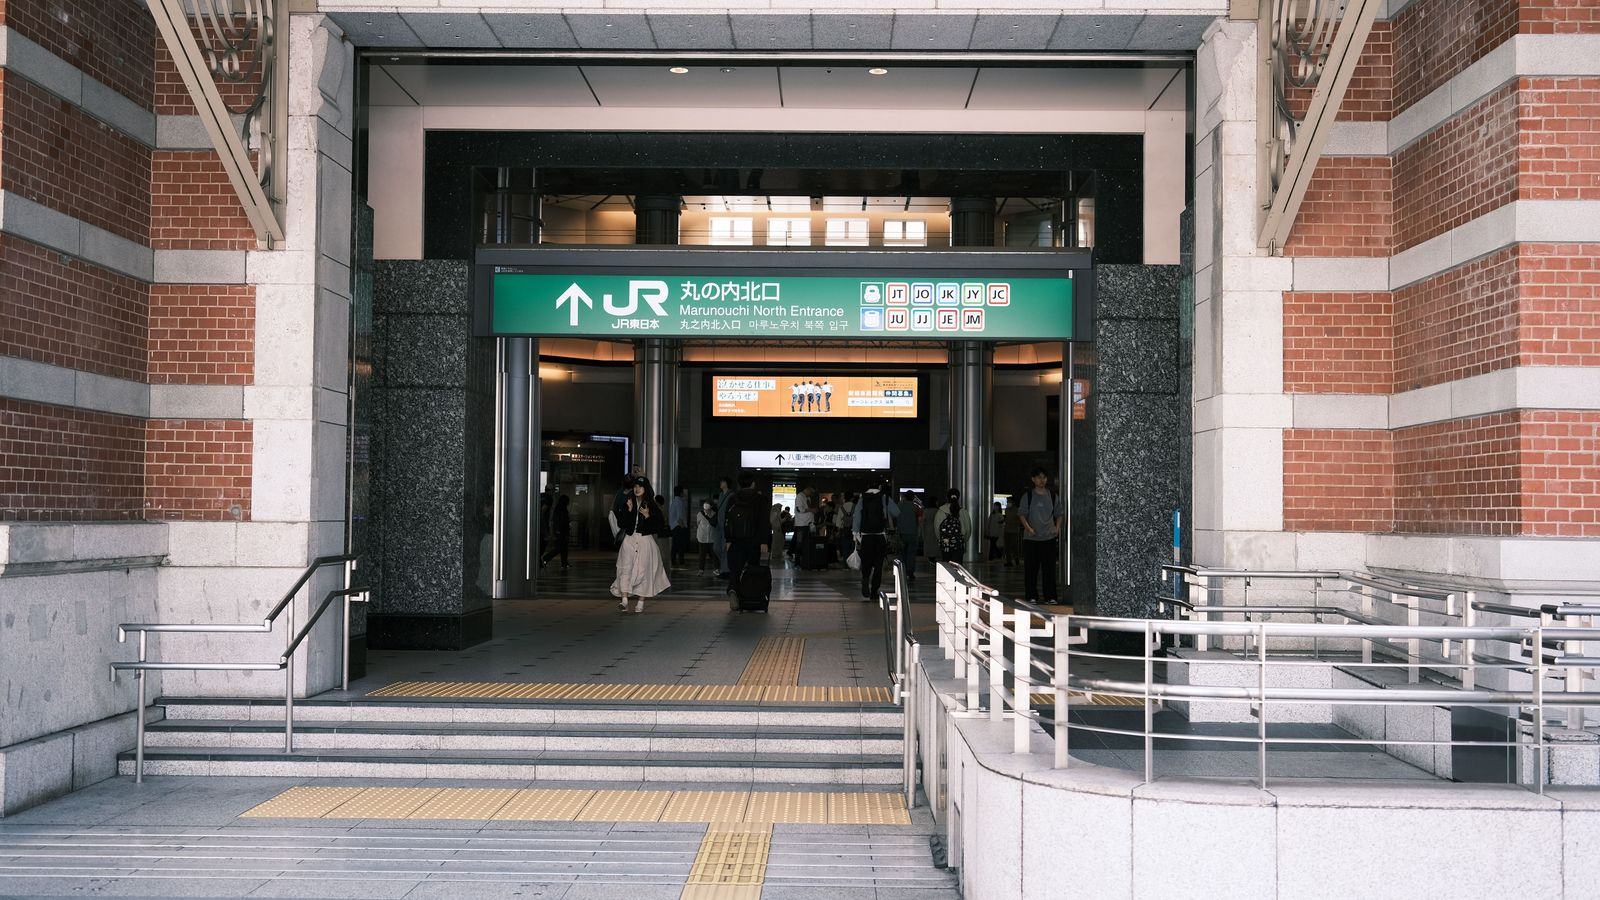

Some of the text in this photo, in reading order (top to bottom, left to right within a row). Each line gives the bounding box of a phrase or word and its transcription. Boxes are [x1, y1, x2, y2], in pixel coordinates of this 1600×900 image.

[680, 281, 780, 302] 丸の内北口
[892, 290, 1004, 299] JT JO JK JY JC
[603, 280, 669, 317] JR
[680, 305, 845, 318] Marunouchi North Entrance
[611, 319, 660, 330] JR東日本
[680, 319, 741, 331] 丸之内北入口
[749, 320, 849, 331] 마루노우치 북쪽 입구
[891, 315, 981, 325] JU JJ JE JM
